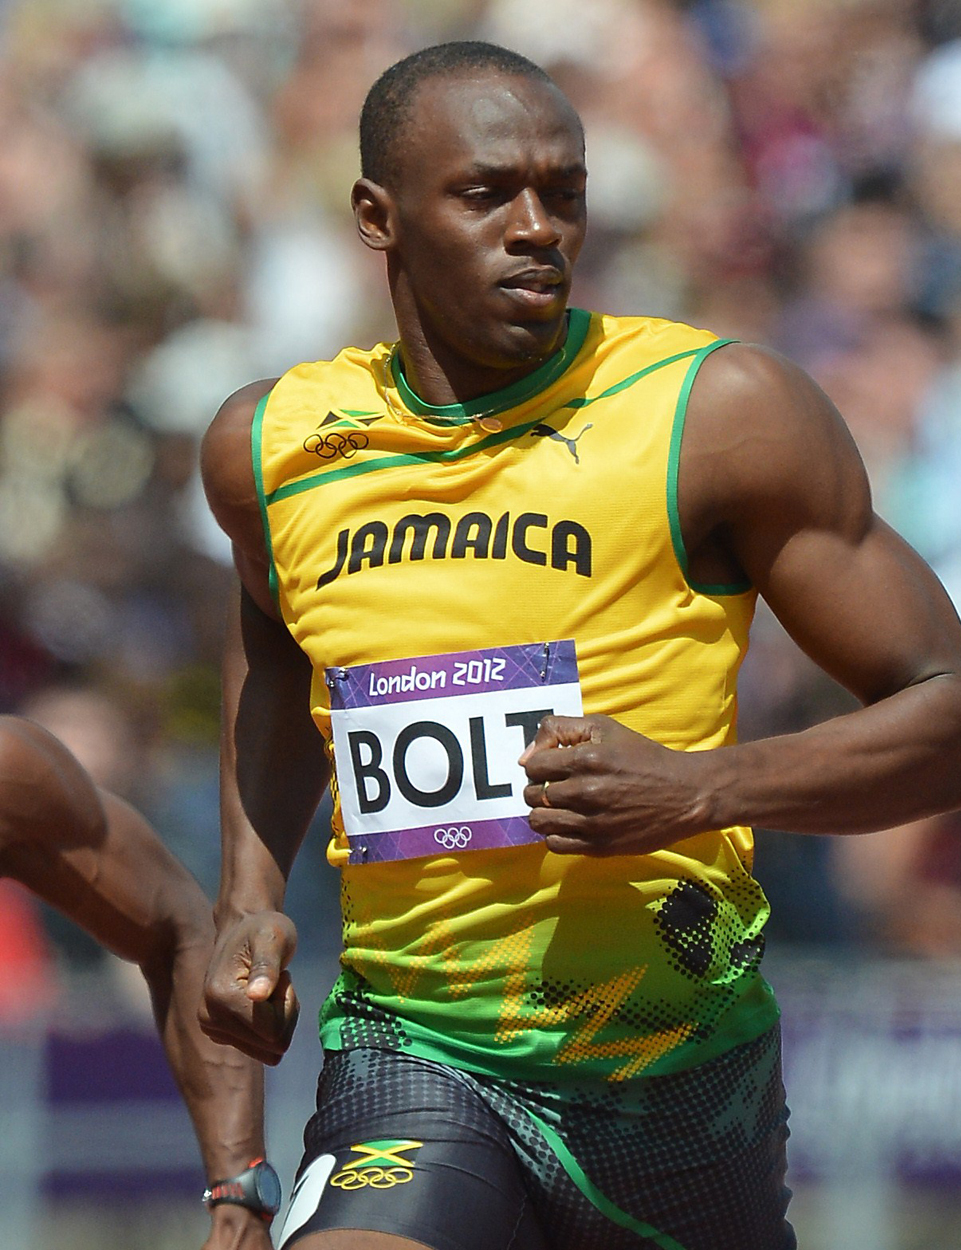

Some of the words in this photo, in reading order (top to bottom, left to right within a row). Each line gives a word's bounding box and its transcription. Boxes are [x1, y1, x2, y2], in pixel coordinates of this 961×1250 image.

[316, 511, 593, 591] JAMAICA
[368, 665, 447, 697] London
[452, 657, 506, 686] 2012
